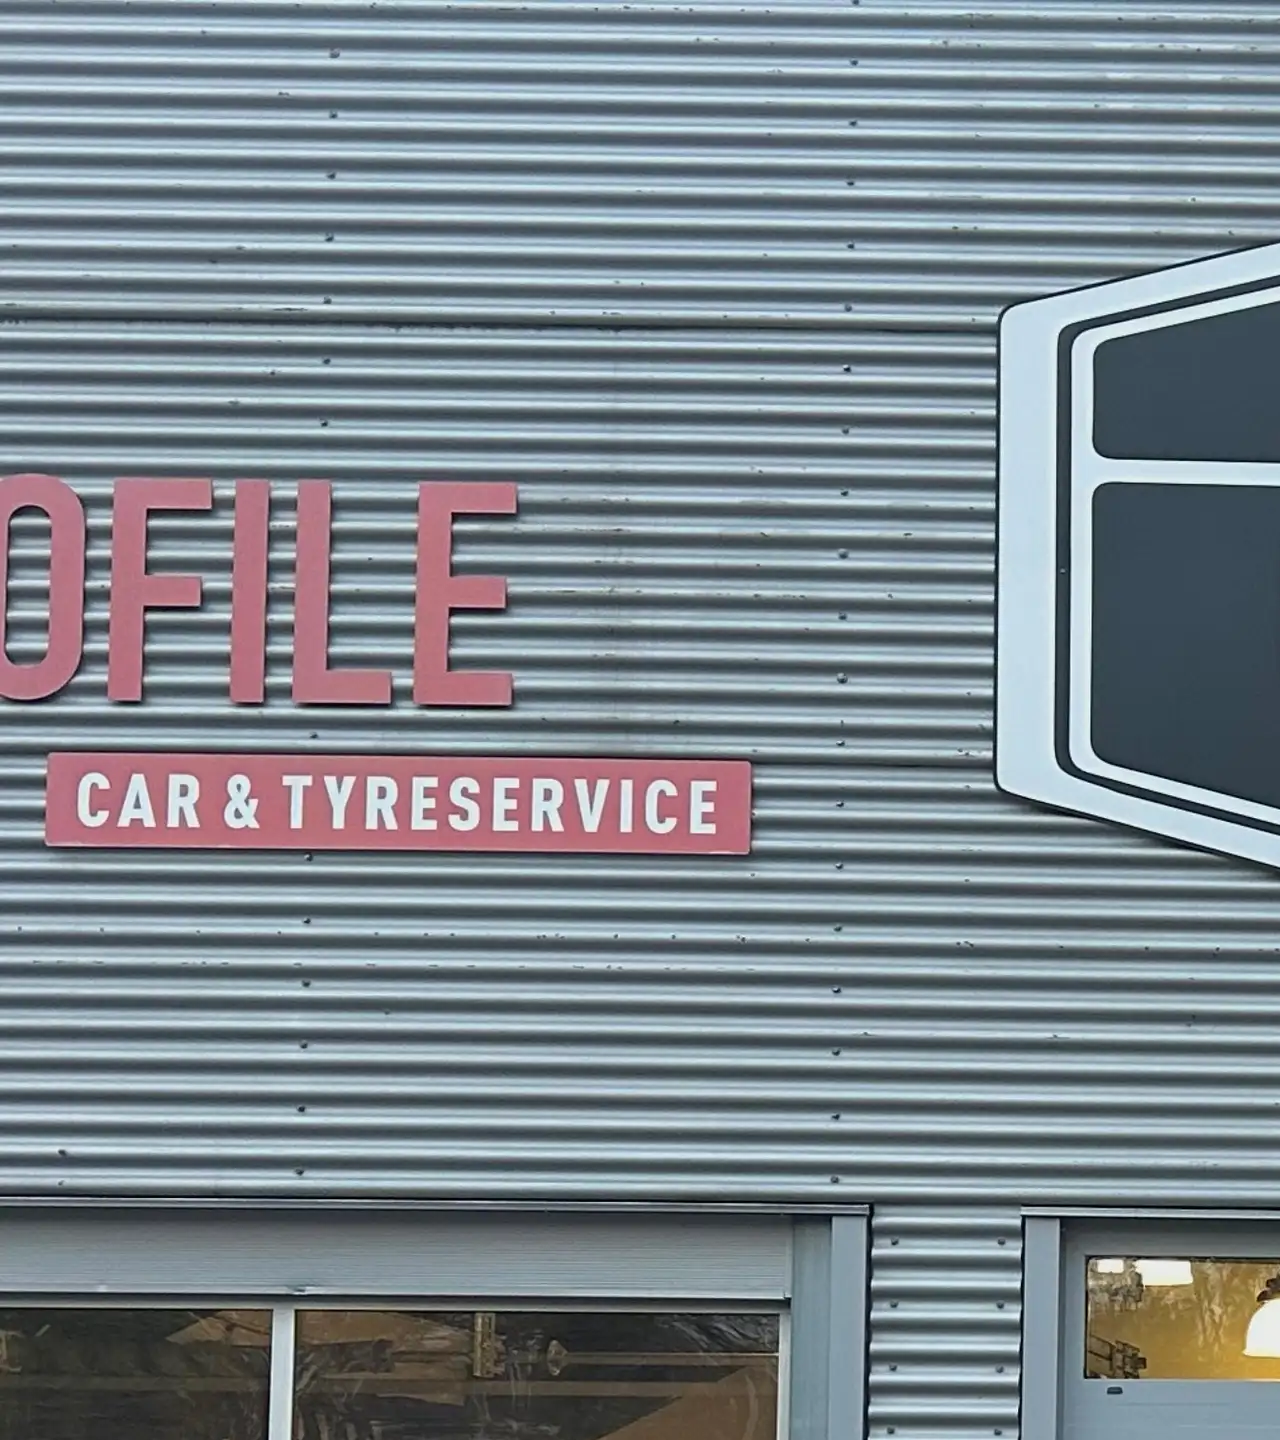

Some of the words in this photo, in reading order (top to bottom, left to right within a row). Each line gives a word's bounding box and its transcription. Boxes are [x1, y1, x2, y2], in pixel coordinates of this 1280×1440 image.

[76, 772, 200, 828] CAR
[223, 774, 260, 830] &
[282, 775, 717, 835] TYRESERVICE
